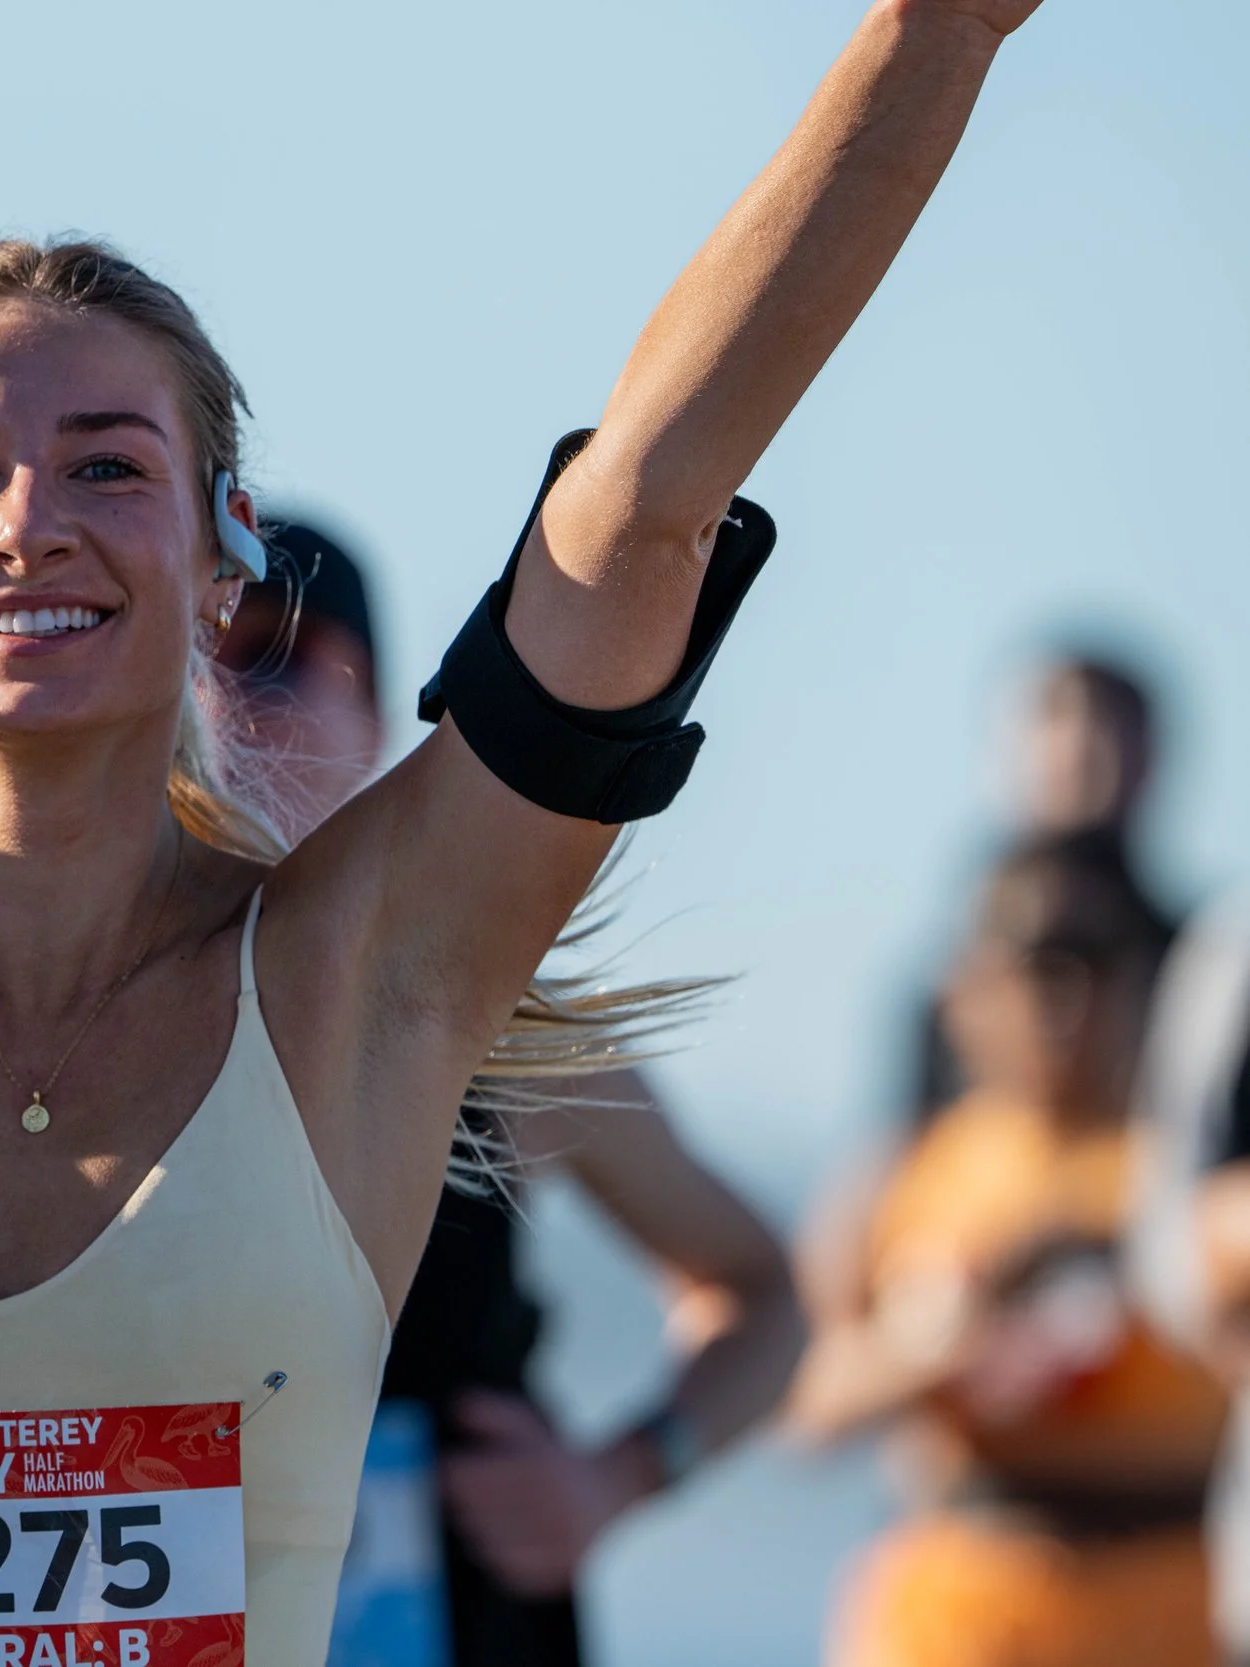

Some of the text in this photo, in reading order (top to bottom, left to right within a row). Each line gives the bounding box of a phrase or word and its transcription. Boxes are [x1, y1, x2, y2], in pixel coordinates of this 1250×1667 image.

[23, 1452, 65, 1472] HALF
[23, 1470, 105, 1493] MARATHON
[119, 1628, 150, 1667] B
